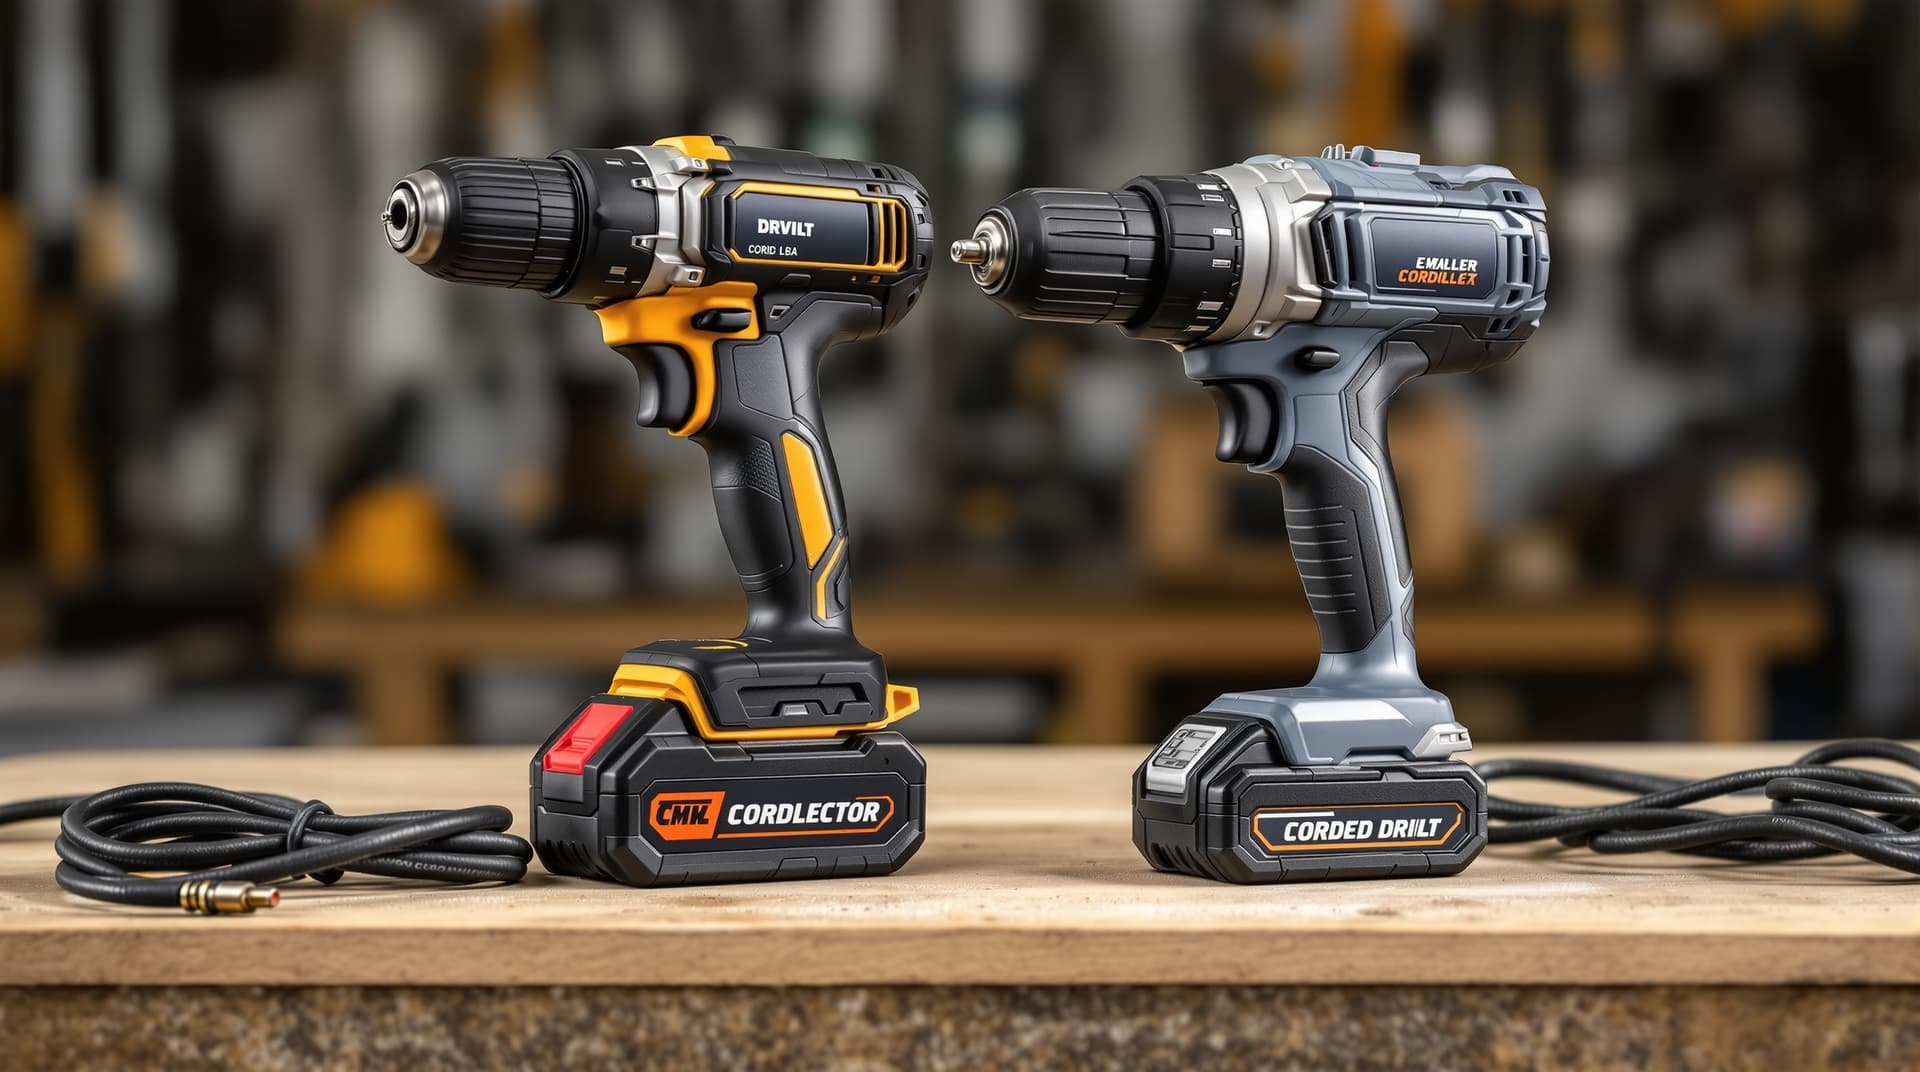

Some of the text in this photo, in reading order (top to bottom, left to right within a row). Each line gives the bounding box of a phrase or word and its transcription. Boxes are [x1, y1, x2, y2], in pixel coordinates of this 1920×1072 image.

[757, 218, 815, 237] DRVILT
[727, 801, 880, 825] CORDLECTOR
[1283, 819, 1373, 842] CORDED
